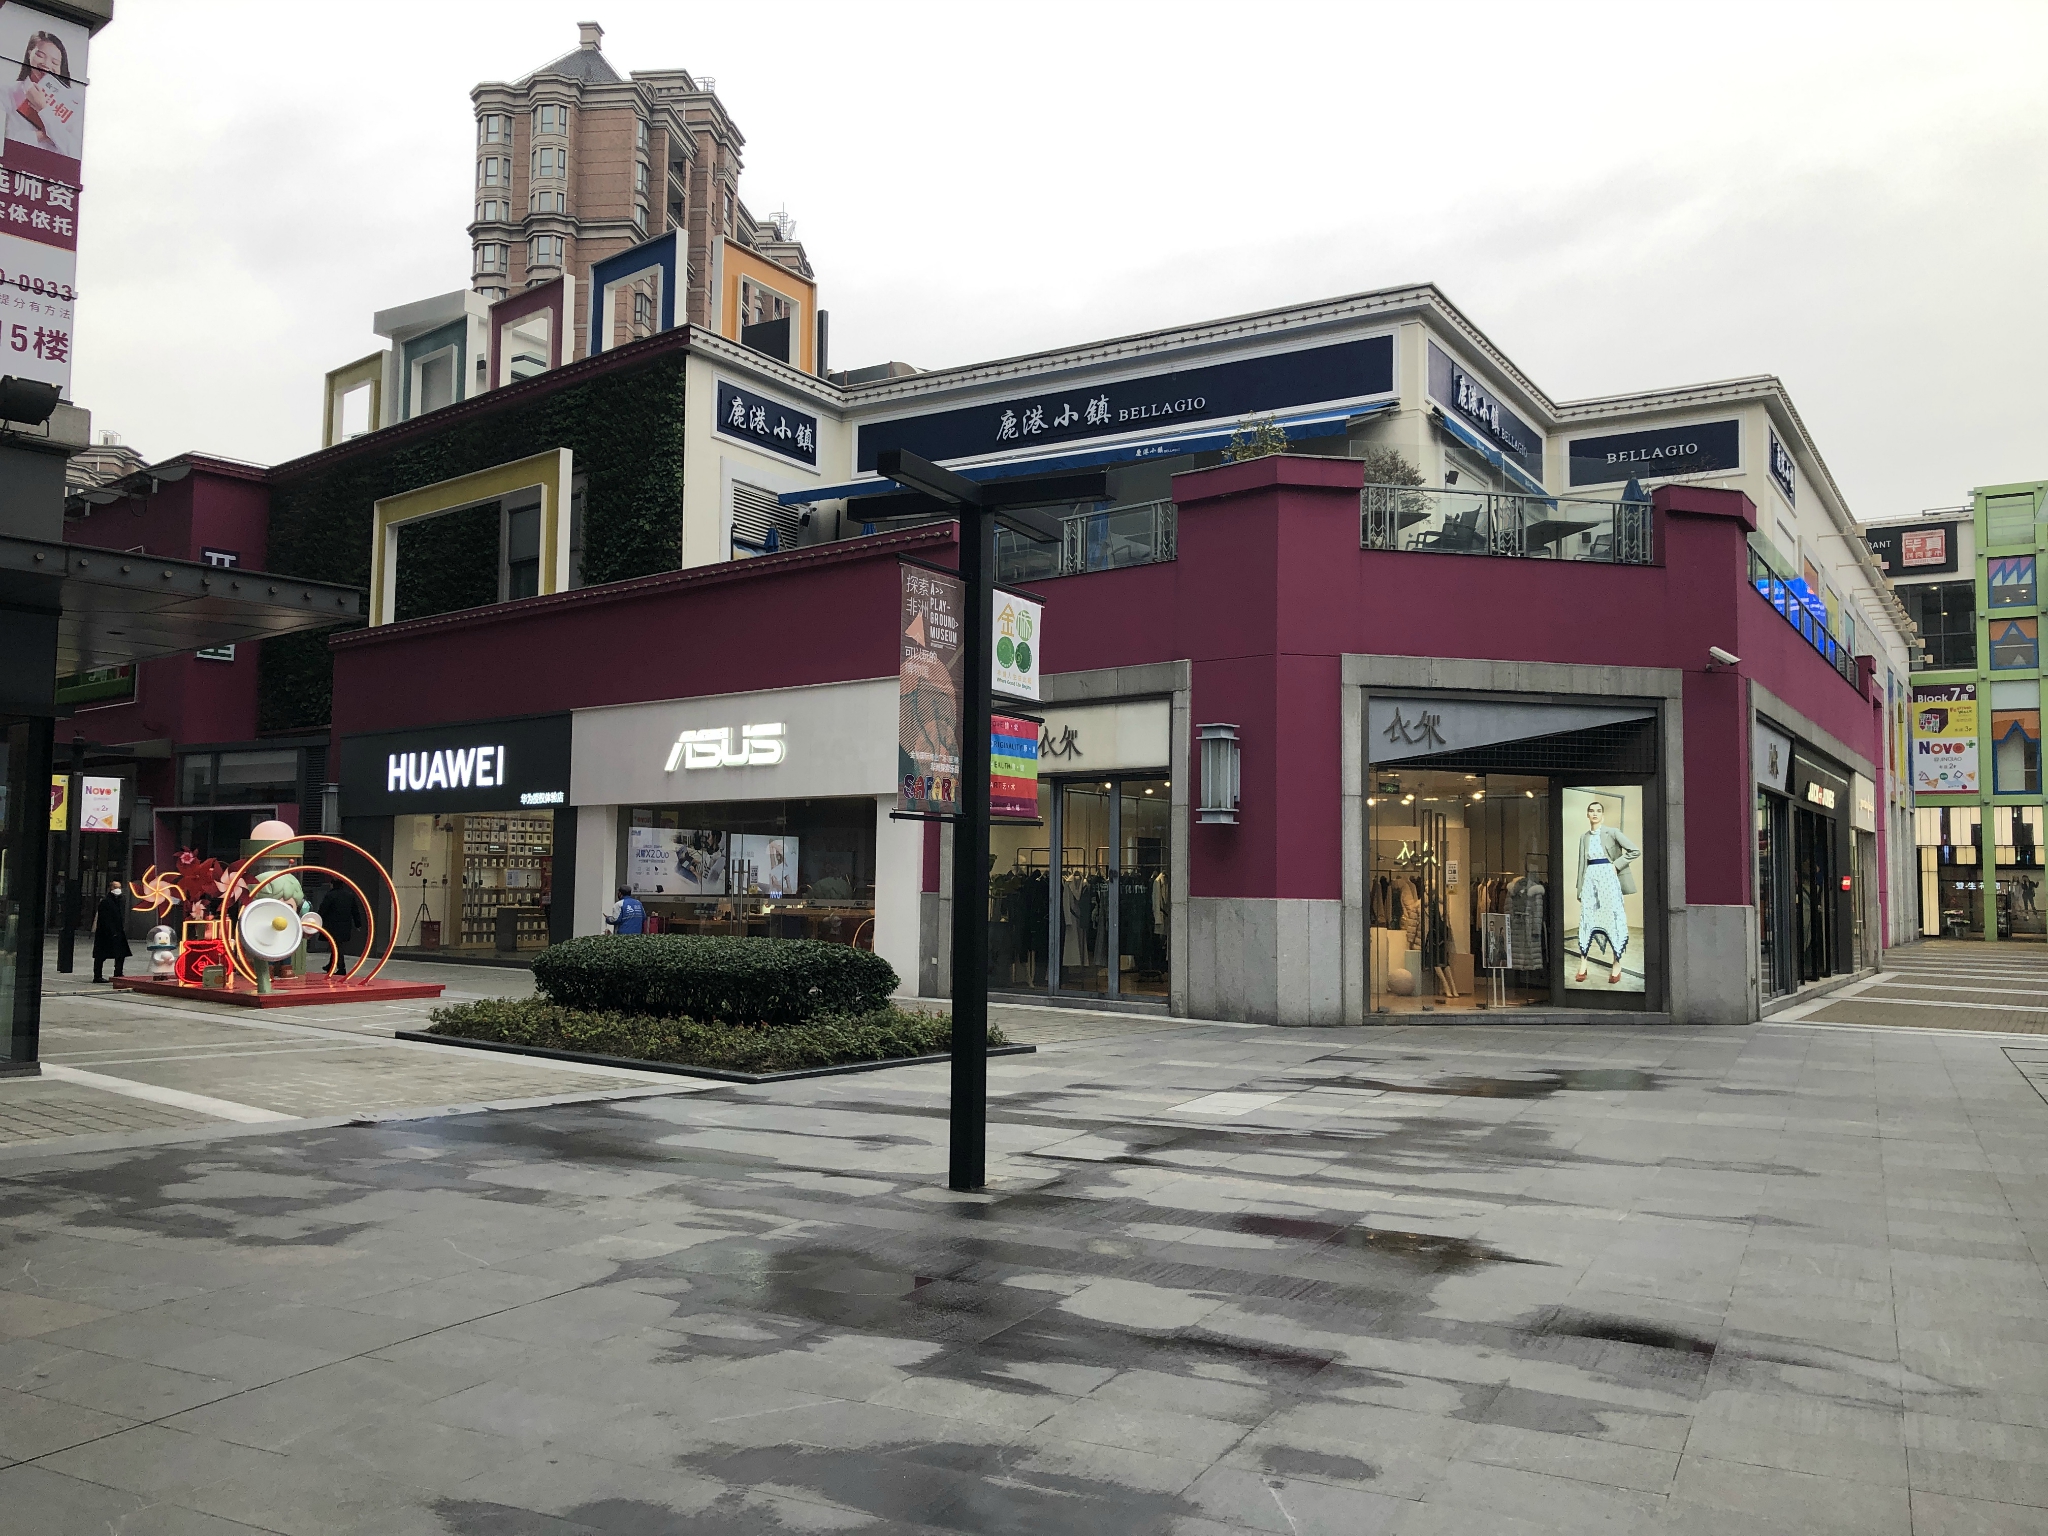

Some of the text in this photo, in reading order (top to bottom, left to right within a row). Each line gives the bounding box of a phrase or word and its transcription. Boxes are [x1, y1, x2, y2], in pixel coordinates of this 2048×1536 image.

[0, 200, 73, 237] 体依托
[727, 395, 815, 454] 鹿港小鎮
[995, 393, 1207, 442] 鹿港小鎮 BELLAGIO
[1501, 427, 1528, 458] BELLAGIO
[1605, 442, 1699, 465] BELLAGIO
[906, 574, 929, 597] 探索
[906, 597, 928, 620] 非洲
[929, 626, 957, 645] MUSEUM
[1917, 694, 1948, 703] Block
[664, 721, 786, 773] ASUS
[387, 745, 505, 793] HUAWEI
[408, 861, 424, 877] 5G
